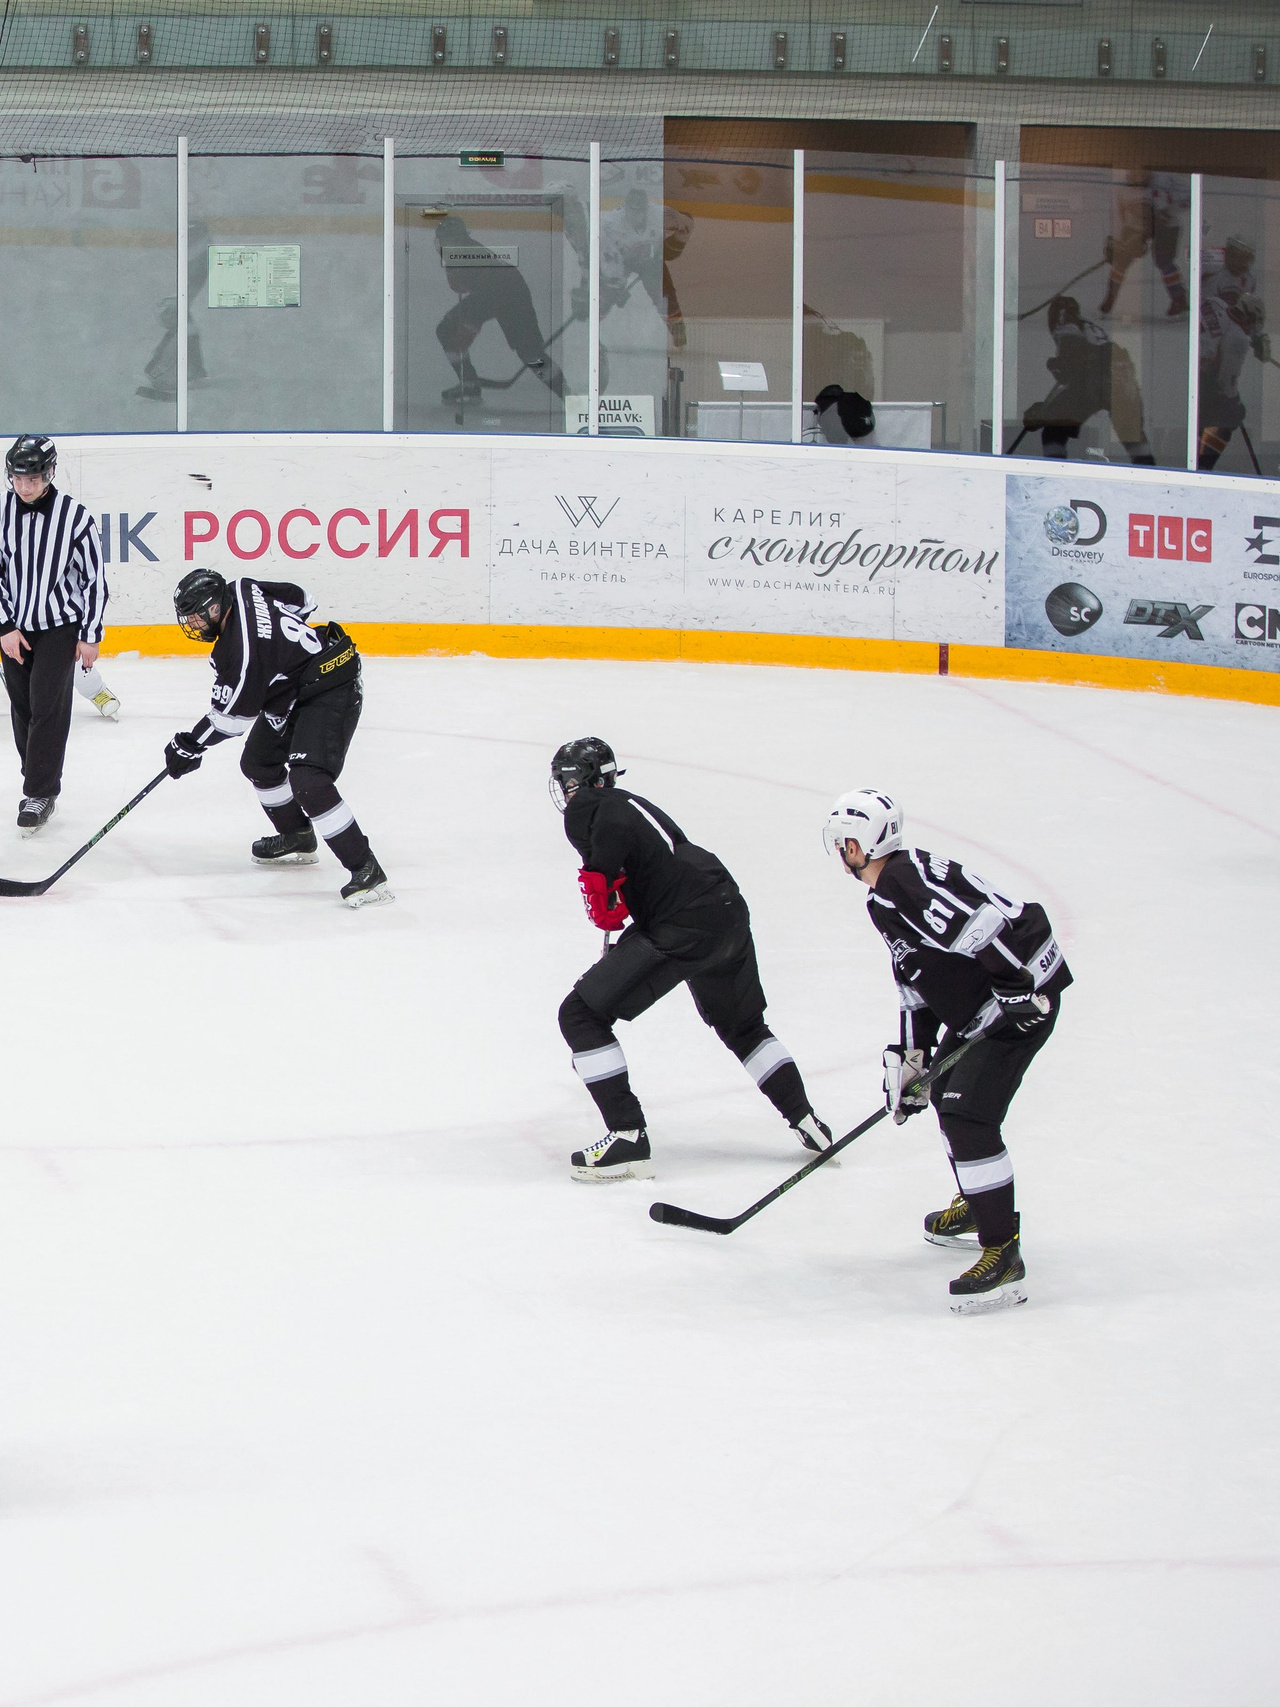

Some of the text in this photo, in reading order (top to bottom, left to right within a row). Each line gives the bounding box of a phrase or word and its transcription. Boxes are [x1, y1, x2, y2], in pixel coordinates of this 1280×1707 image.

[449, 252, 492, 260] СЛУЖЕБНЫЙ
[597, 399, 633, 412] АША
[578, 413, 623, 423] ГРППА
[713, 507, 841, 528] КАРЕЛИЯ
[183, 508, 471, 561] РОССИЯ
[498, 538, 669, 559] ДАЧА ВИНТЕРА
[707, 528, 1000, 582] с комфортом
[1051, 546, 1105, 565] Discovery
[540, 571, 627, 584] ПАРК-ОТЕЛЬ
[1243, 571, 1280, 582] EUROSPO
[707, 577, 897, 596] WWW.DACHAWINTERA.RU
[1070, 606, 1092, 623] SC
